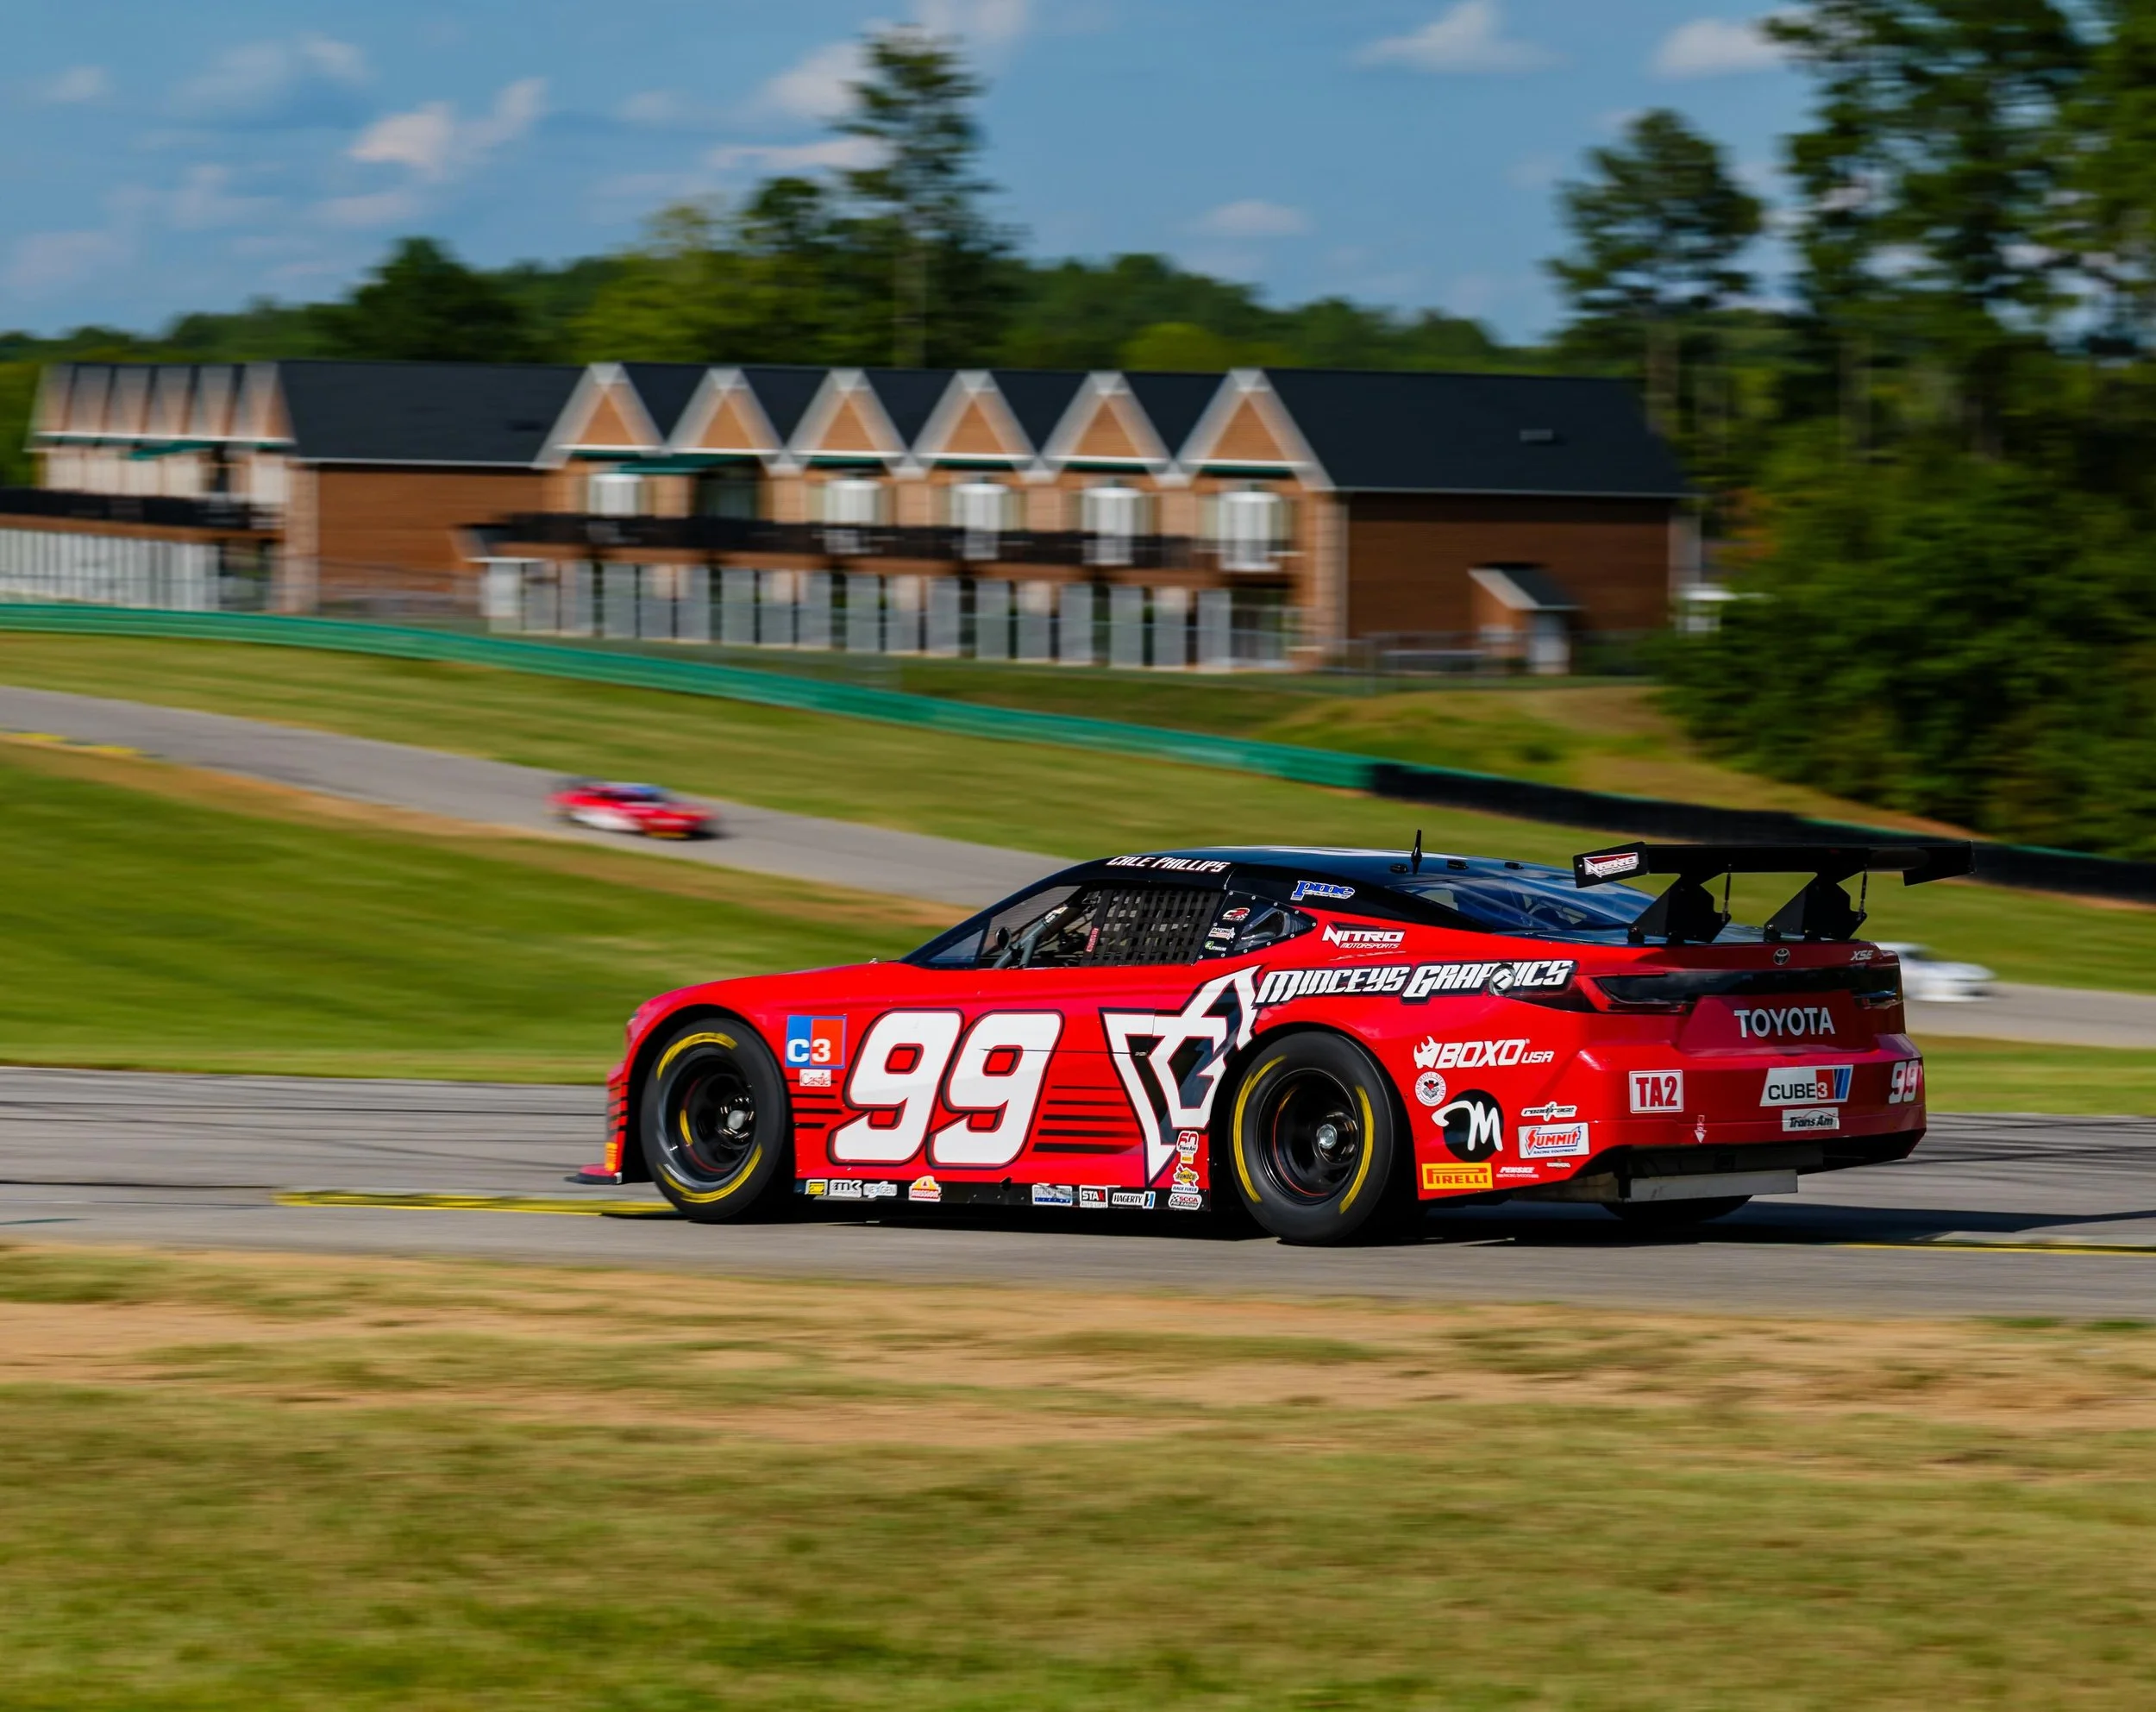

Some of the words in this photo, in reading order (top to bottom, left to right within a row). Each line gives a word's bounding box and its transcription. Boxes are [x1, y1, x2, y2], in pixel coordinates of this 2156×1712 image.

[1106, 856, 1156, 867] CALE
[1150, 856, 1232, 873] PHILLIPS
[1321, 924, 1406, 947] NITRO
[1850, 950, 1873, 961] XSE
[1255, 966, 1411, 1004] MINCEYS
[1733, 1007, 1835, 1038] TOYOTA
[787, 1038, 831, 1063] C3
[1435, 1039, 1526, 1069] BOXO
[1520, 1050, 1554, 1064] USA
[832, 1011, 1062, 1166] 99
[1635, 1075, 1677, 1107] TA2
[1889, 1060, 1919, 1104] 99
[1789, 1116, 1814, 1128] Trans
[1816, 1114, 1833, 1126] Am
[1175, 1171, 1198, 1181] SUNOCO
[1426, 1167, 1489, 1185] PIRELLI
[1113, 1193, 1143, 1204] HAGERTY
